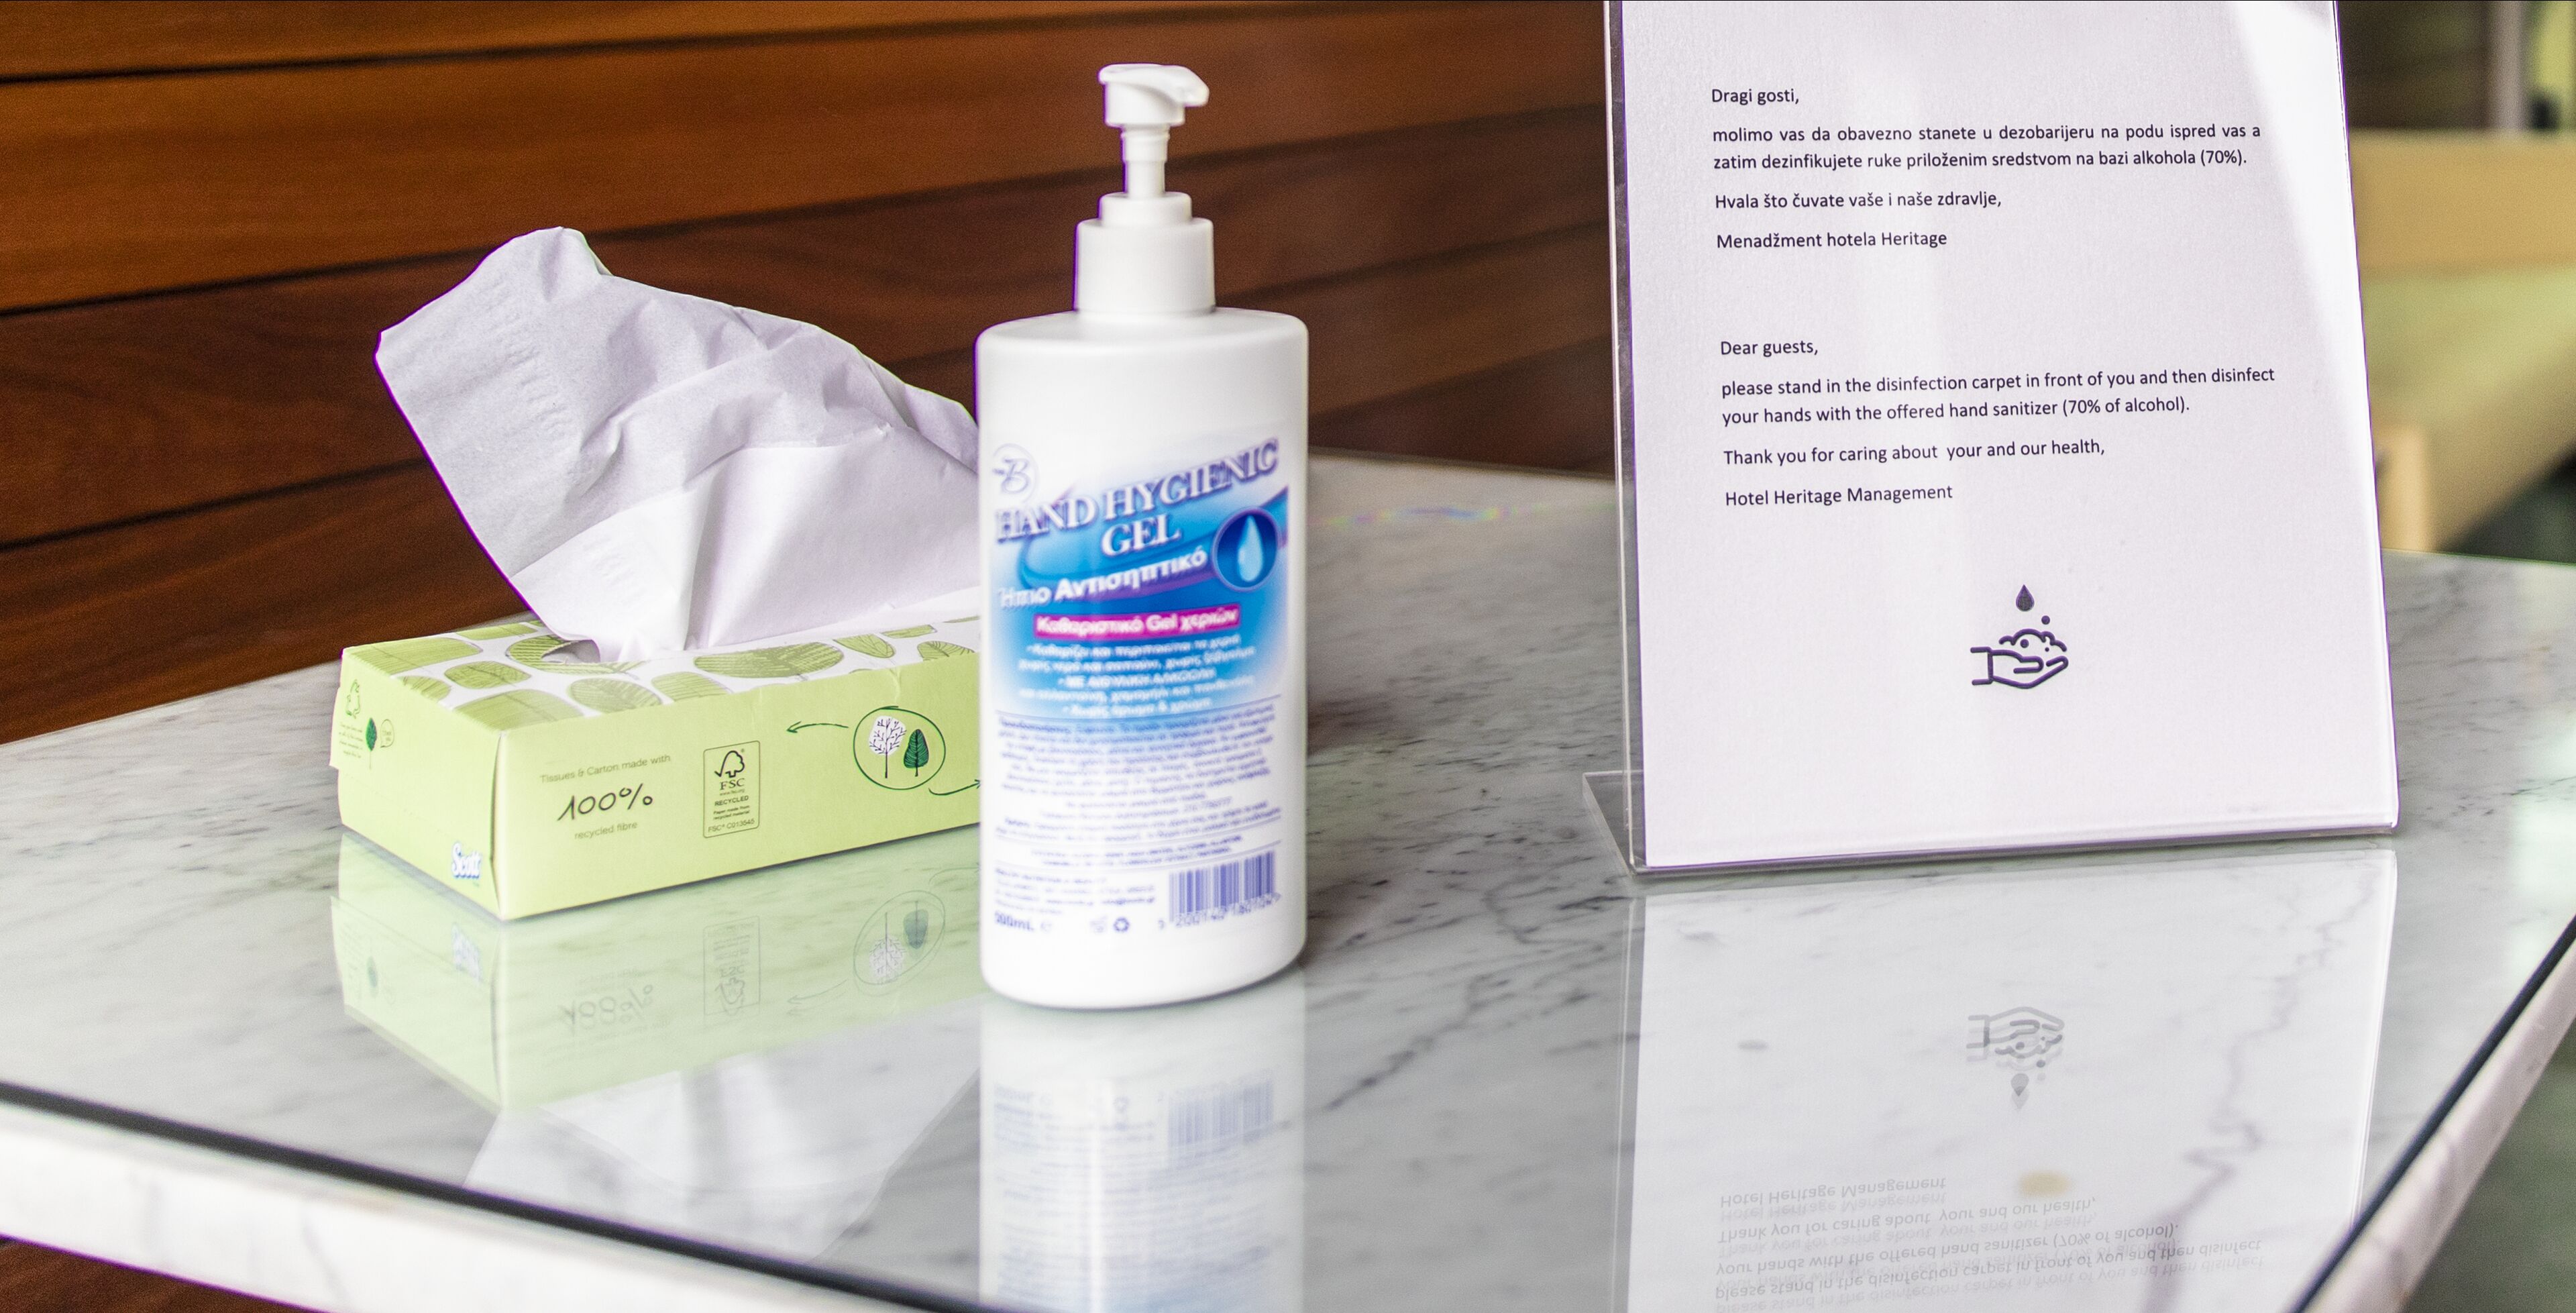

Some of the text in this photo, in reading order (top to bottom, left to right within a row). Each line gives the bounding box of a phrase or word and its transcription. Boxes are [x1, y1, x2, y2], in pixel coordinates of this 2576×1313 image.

[1711, 88, 1799, 106] Dragi gosti,
[1713, 123, 2261, 142] molimo vas da obavezno stanete u dezobarijeru na podu ispred vas a
[1713, 148, 2247, 172] zatim dezinfikujete ruke priloženim sredstvom na bazi alkohola (70%).
[1715, 190, 2002, 209] Hvala što čuvate vaše i naše zdravlje,
[1717, 231, 1947, 249] Menadžment hotela Heritage
[1720, 340, 1819, 358] Dear guests,
[1721, 366, 2275, 400] please stand in the disinfection carpet in front of you and then disinfect
[1721, 395, 2190, 428] your hands with the offered hand sanitizer (70% of alcohol).
[1723, 438, 2105, 467] Thank you for caring about your and our health,
[996, 437, 1279, 543] HAND HYGIENIC
[1725, 485, 1953, 507] Hotel Heritage Management
[1102, 514, 1181, 557] GEL
[1056, 545, 1208, 600] Αντισηπτικό
[1146, 613, 1177, 631] Gel
[539, 754, 671, 784] Tissues & Carton made with
[719, 778, 745, 790] FSC
[557, 783, 653, 821] 100%
[714, 795, 749, 806] RECYCLED
[574, 821, 638, 839] recycled fibre
